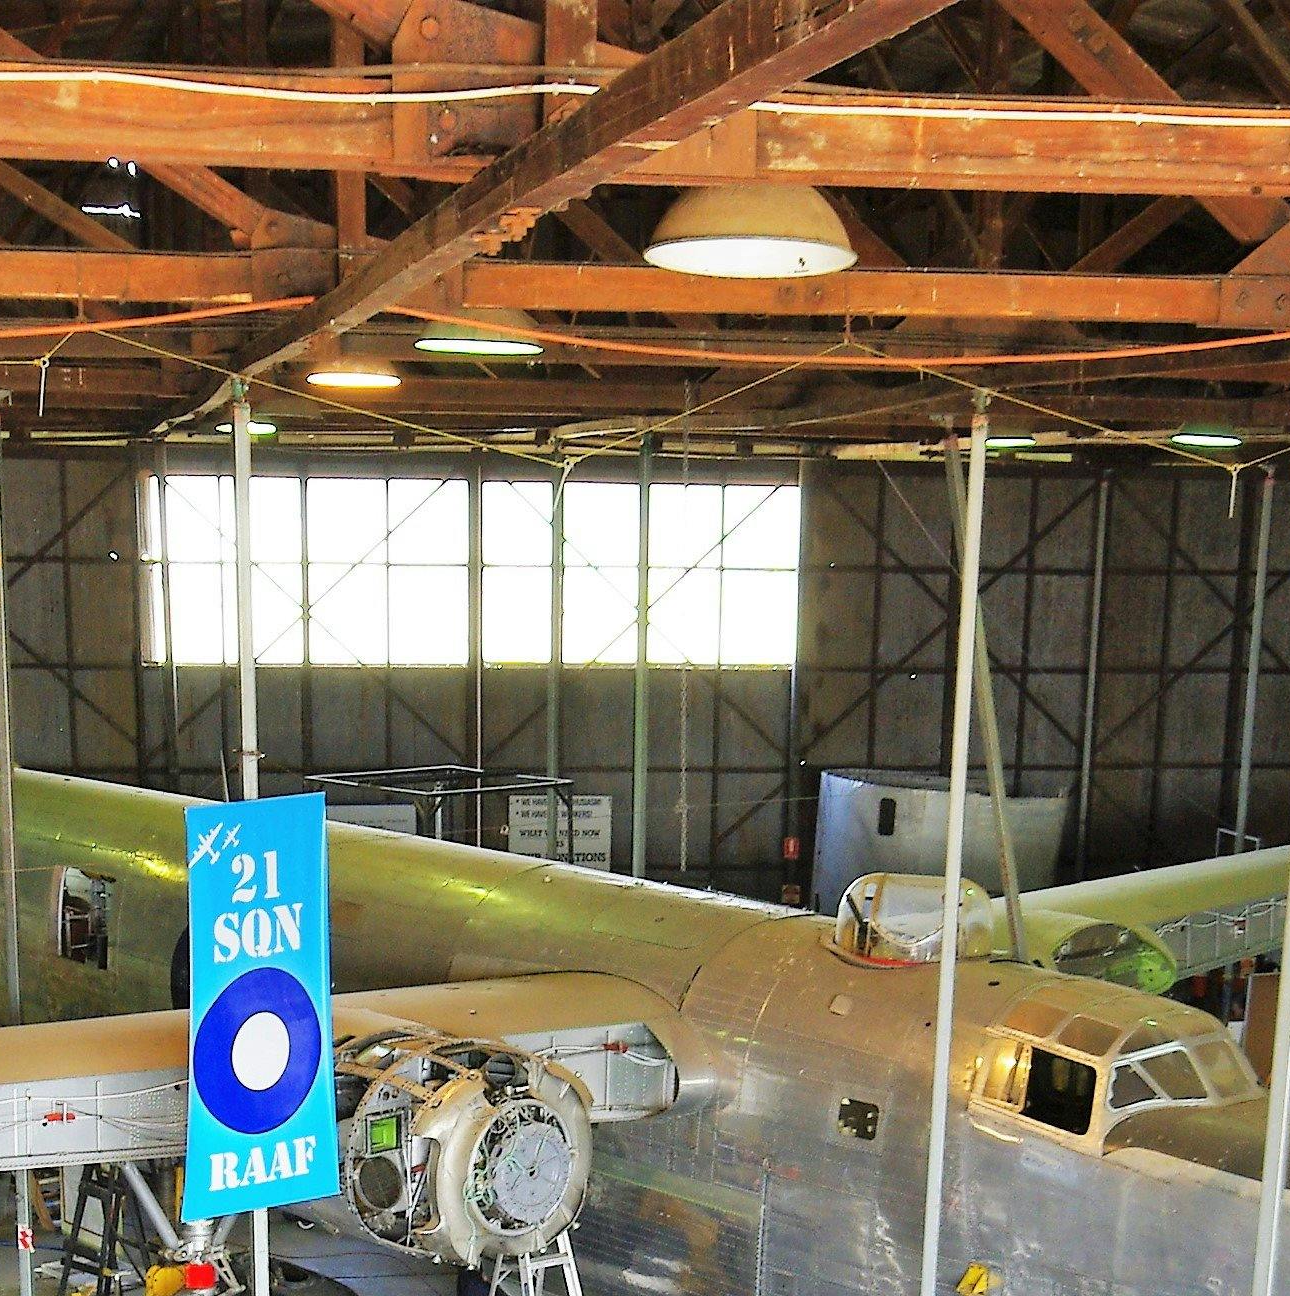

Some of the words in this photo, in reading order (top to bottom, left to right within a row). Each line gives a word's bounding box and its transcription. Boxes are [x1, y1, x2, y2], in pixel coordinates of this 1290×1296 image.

[230, 849, 282, 904] 21
[213, 902, 303, 963] SQN
[208, 1135, 318, 1192] RAAF
